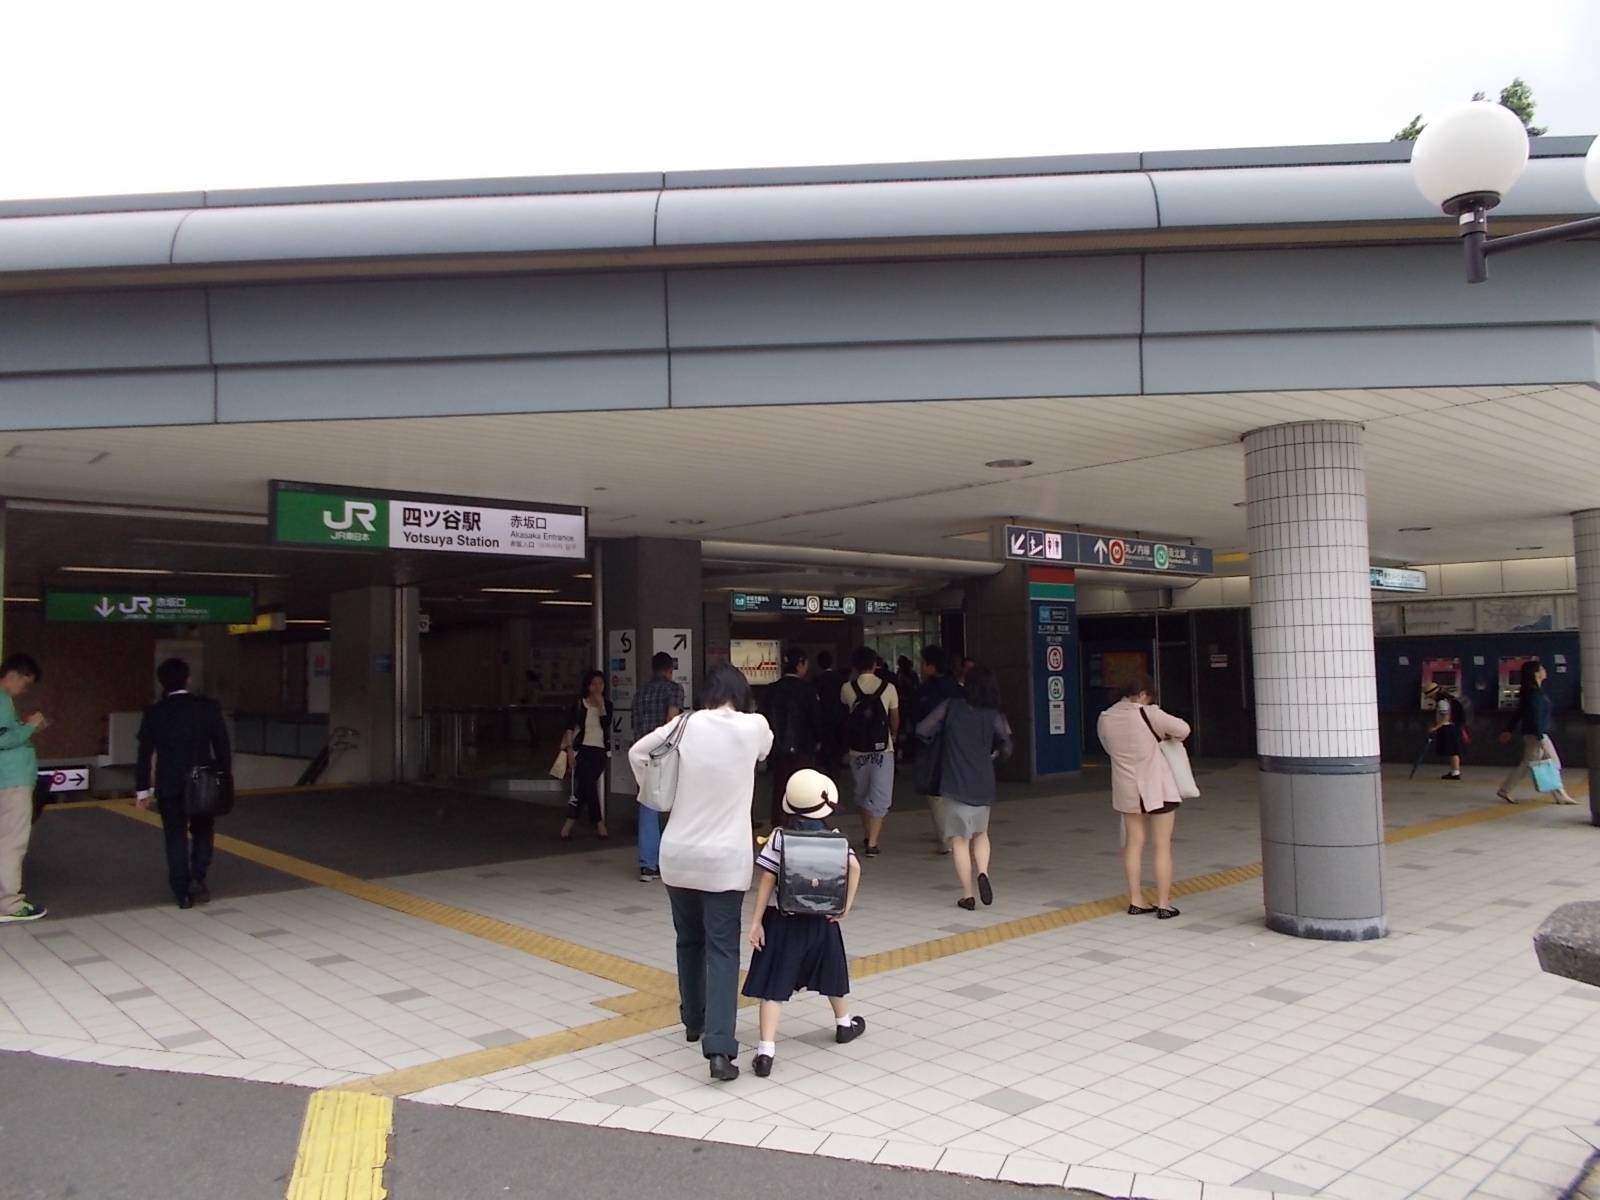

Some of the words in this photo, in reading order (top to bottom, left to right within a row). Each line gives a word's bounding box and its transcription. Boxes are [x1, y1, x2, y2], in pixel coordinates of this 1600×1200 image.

[323, 500, 377, 532] JR
[402, 507, 481, 532] 四ツ谷駅
[510, 515, 547, 530] 赤坂口
[330, 531, 370, 541] JR東日本
[403, 531, 453, 547] Yotsuya
[457, 534, 500, 548] Station
[510, 530, 541, 540] Akasaka
[543, 532, 574, 542] Entrance
[119, 597, 153, 614] JR
[156, 598, 186, 607] 赤坂口
